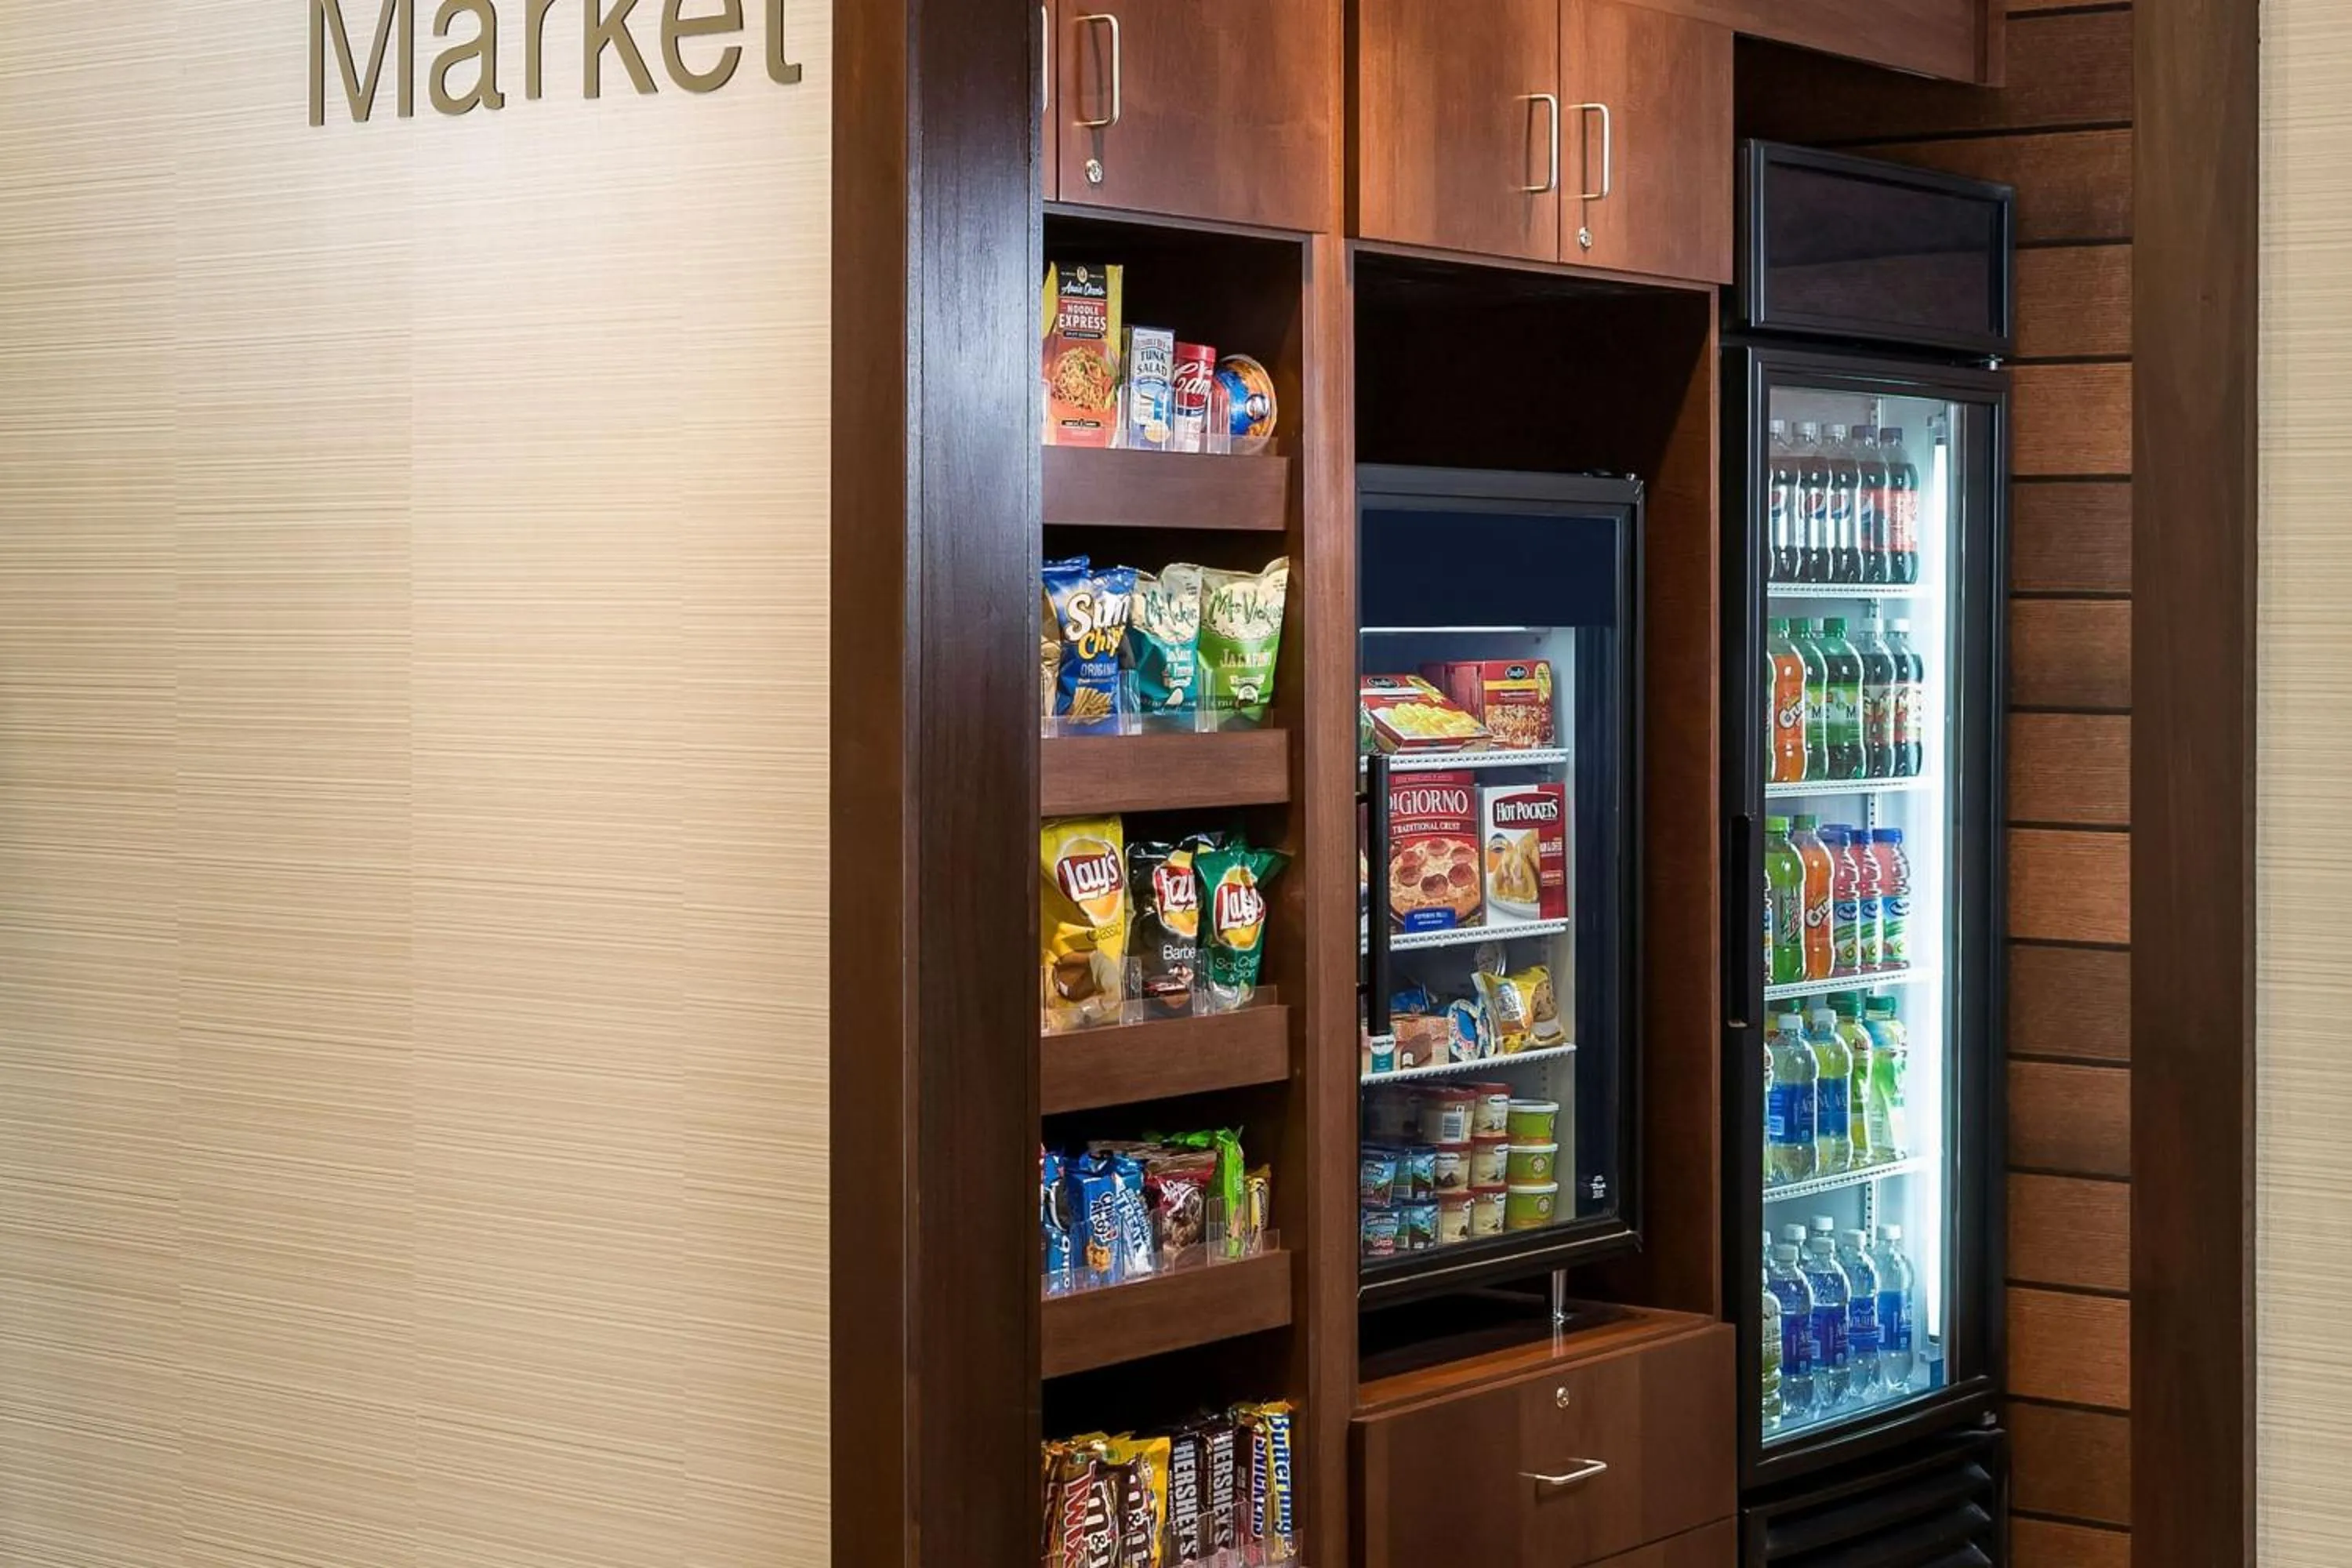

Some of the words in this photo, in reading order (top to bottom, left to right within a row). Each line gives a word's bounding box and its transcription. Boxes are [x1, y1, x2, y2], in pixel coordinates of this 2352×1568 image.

[308, 0, 802, 126] Market
[1058, 314, 1106, 332] EXPRESS
[1137, 363, 1167, 376] SALAD
[1141, 350, 1166, 363] TUNA
[1062, 855, 1119, 902] Lay's
[1174, 1436, 1199, 1560] HERSHEY'S
[1213, 1428, 1234, 1549] HERSHEY'S
